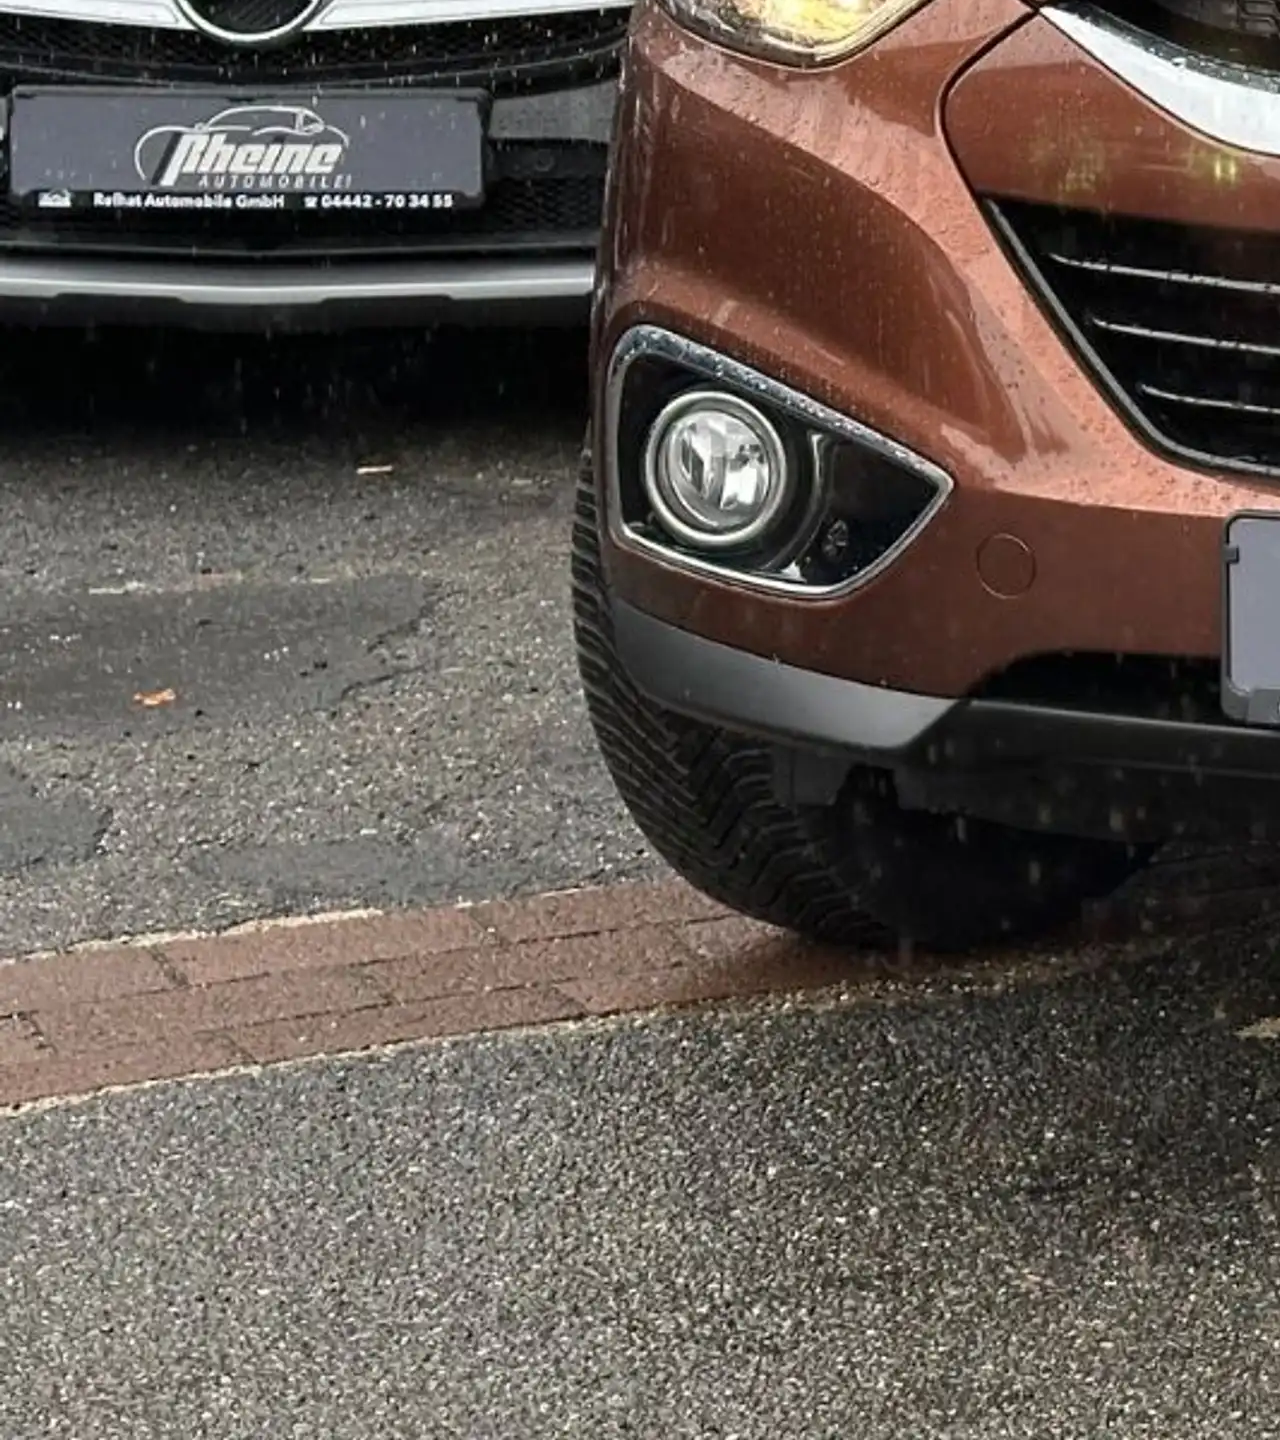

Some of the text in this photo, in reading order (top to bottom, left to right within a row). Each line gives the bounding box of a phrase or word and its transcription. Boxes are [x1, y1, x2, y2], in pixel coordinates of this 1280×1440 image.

[154, 132, 343, 187] Rheine
[143, 192, 233, 208] Automobile
[235, 193, 285, 208] GmbH
